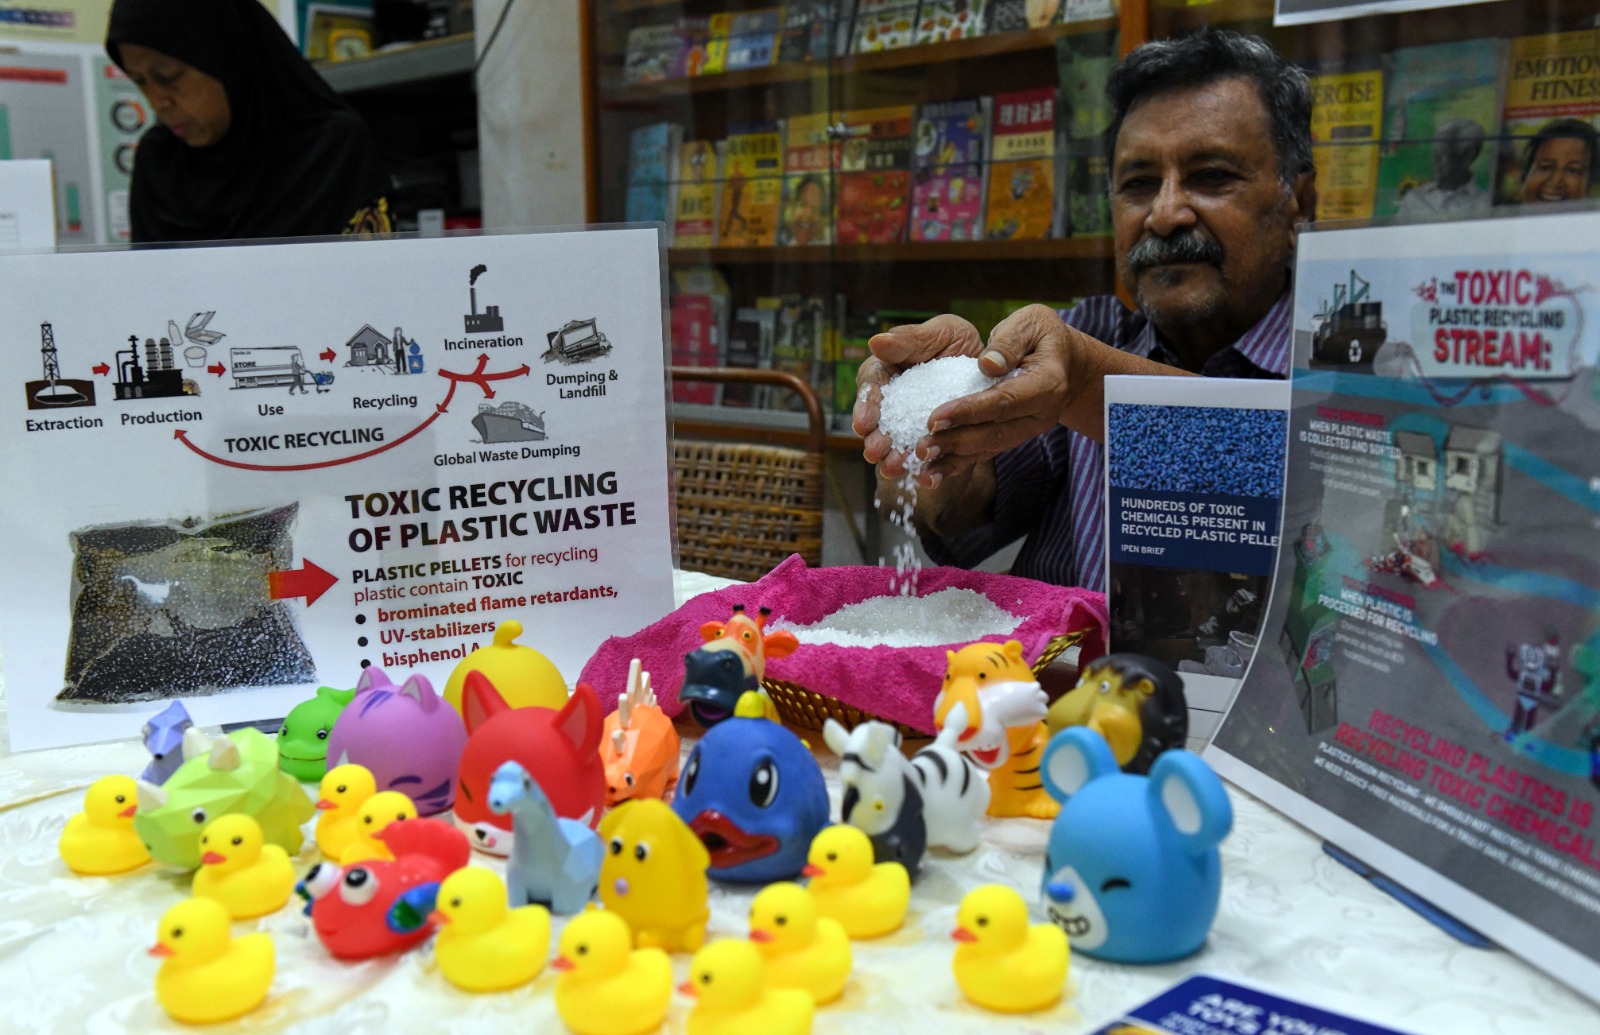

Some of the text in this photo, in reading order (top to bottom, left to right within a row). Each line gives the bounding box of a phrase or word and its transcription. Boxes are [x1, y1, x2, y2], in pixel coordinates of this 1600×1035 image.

[1531, 78, 1600, 101] FITNES
[1455, 269, 1531, 305] TOXIC
[1429, 308, 1565, 329] PLASTIC RECYCLING
[444, 336, 523, 351] Incineration
[1434, 327, 1552, 371] STREAM:
[234, 361, 256, 369] STORE
[546, 370, 618, 388] Dumping &
[353, 394, 418, 410] Recycling
[559, 385, 606, 399] Landfill
[121, 409, 203, 426] Production
[258, 404, 284, 417] Use
[26, 416, 103, 432] Extraction
[1309, 420, 1392, 444] WHEN PLASTIC WASTE
[224, 427, 384, 453] TOXIC RECYCLING
[1299, 430, 1307, 442] IS
[1307, 432, 1351, 450] COLLECTED
[1351, 440, 1369, 453] AND
[1369, 443, 1402, 459] SORTED
[433, 444, 581, 467] Global Waste Dumping
[345, 471, 618, 519] TOXIC RECYCLING
[1121, 497, 1246, 517] HUNDREDS OF TOXIC
[348, 502, 637, 553] OF PLASTIC WASTE
[1121, 510, 1266, 532] CHEMICALS PRESENT IN
[1121, 523, 1280, 547] RECYCLED PLASTIC PELLE
[1121, 544, 1166, 555] IPEN BRIEF
[352, 546, 599, 584] PLASTIC PELLETS for recycling
[354, 571, 524, 606] plastic contain TOXIC
[378, 583, 619, 623] brominated flame retardants,
[1340, 588, 1364, 606] WHEN
[1364, 596, 1402, 620] PLASTIC
[1402, 608, 1414, 622] IS
[1318, 593, 1367, 621] PROCESSED
[1366, 610, 1386, 627] FOR
[1385, 616, 1439, 646] RECYCLING
[380, 619, 496, 645] UV-stabilizers
[382, 643, 467, 668] bisphenol
[1368, 708, 1594, 829] RECYCLING PLASTICS IS
[1334, 720, 1600, 871] RECYCLING TOXIC CHEMICAL
